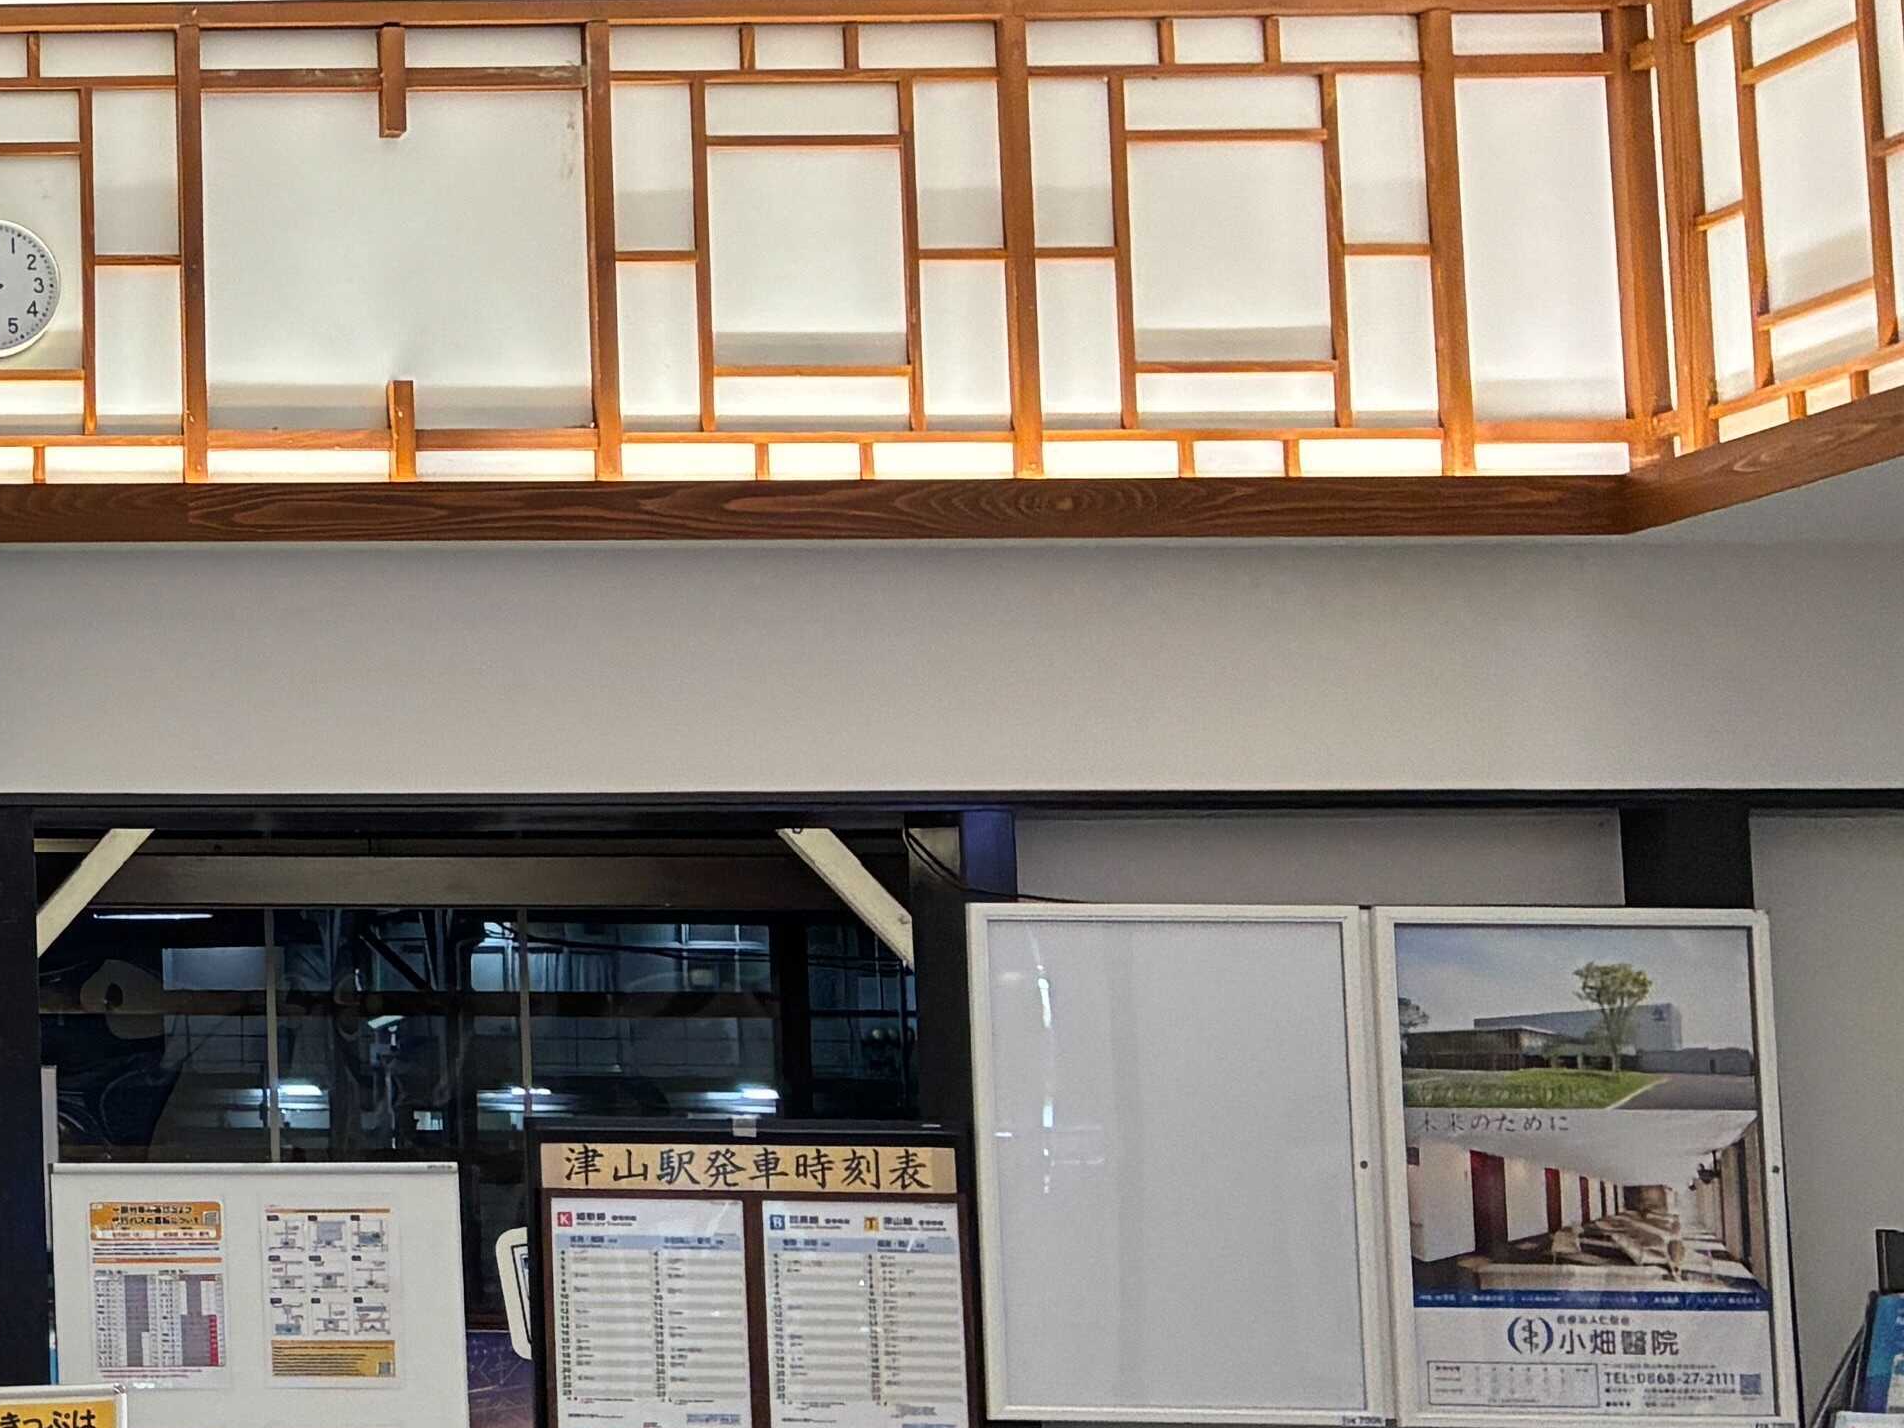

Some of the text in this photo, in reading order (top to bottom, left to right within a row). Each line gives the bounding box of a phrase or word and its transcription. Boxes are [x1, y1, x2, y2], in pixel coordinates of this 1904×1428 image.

[26, 254, 38, 271] 2
[33, 277, 45, 294] 3
[26, 300, 39, 317] 4
[8, 317, 19, 334] 5
[564, 1145, 933, 1190] 津山駅発車時刻表
[560, 1213, 571, 1225] K
[1558, 1328, 1680, 1357] 小畑醫院
